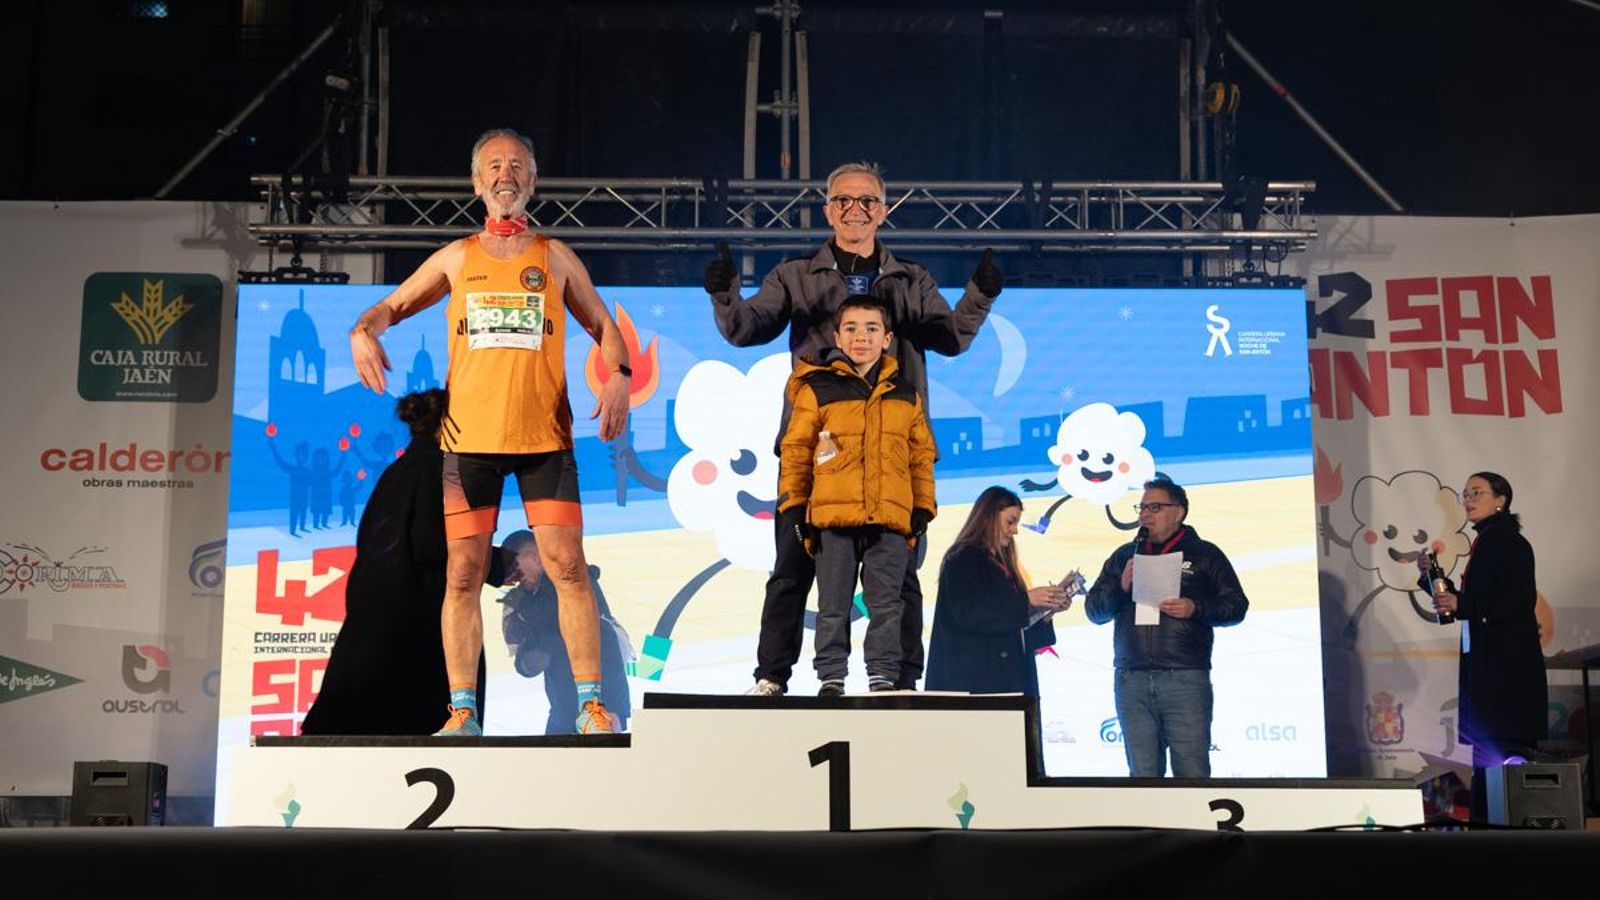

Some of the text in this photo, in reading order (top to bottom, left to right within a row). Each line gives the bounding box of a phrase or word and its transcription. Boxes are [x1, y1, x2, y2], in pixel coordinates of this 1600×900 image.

[474, 308, 537, 328] 2943
[1385, 274, 1556, 344] SAN
[90, 350, 208, 367] CAJA RURAL
[122, 365, 172, 384] JAÉN
[82, 477, 194, 490] obras maestras
[256, 545, 359, 627] 42
[254, 632, 317, 644] CARRERA
[254, 646, 328, 654] INTERNACIONAL
[102, 698, 187, 714] austral
[1245, 722, 1297, 742] alsa
[807, 741, 851, 832] 1
[404, 767, 456, 830] 2
[1208, 798, 1245, 832] 3
